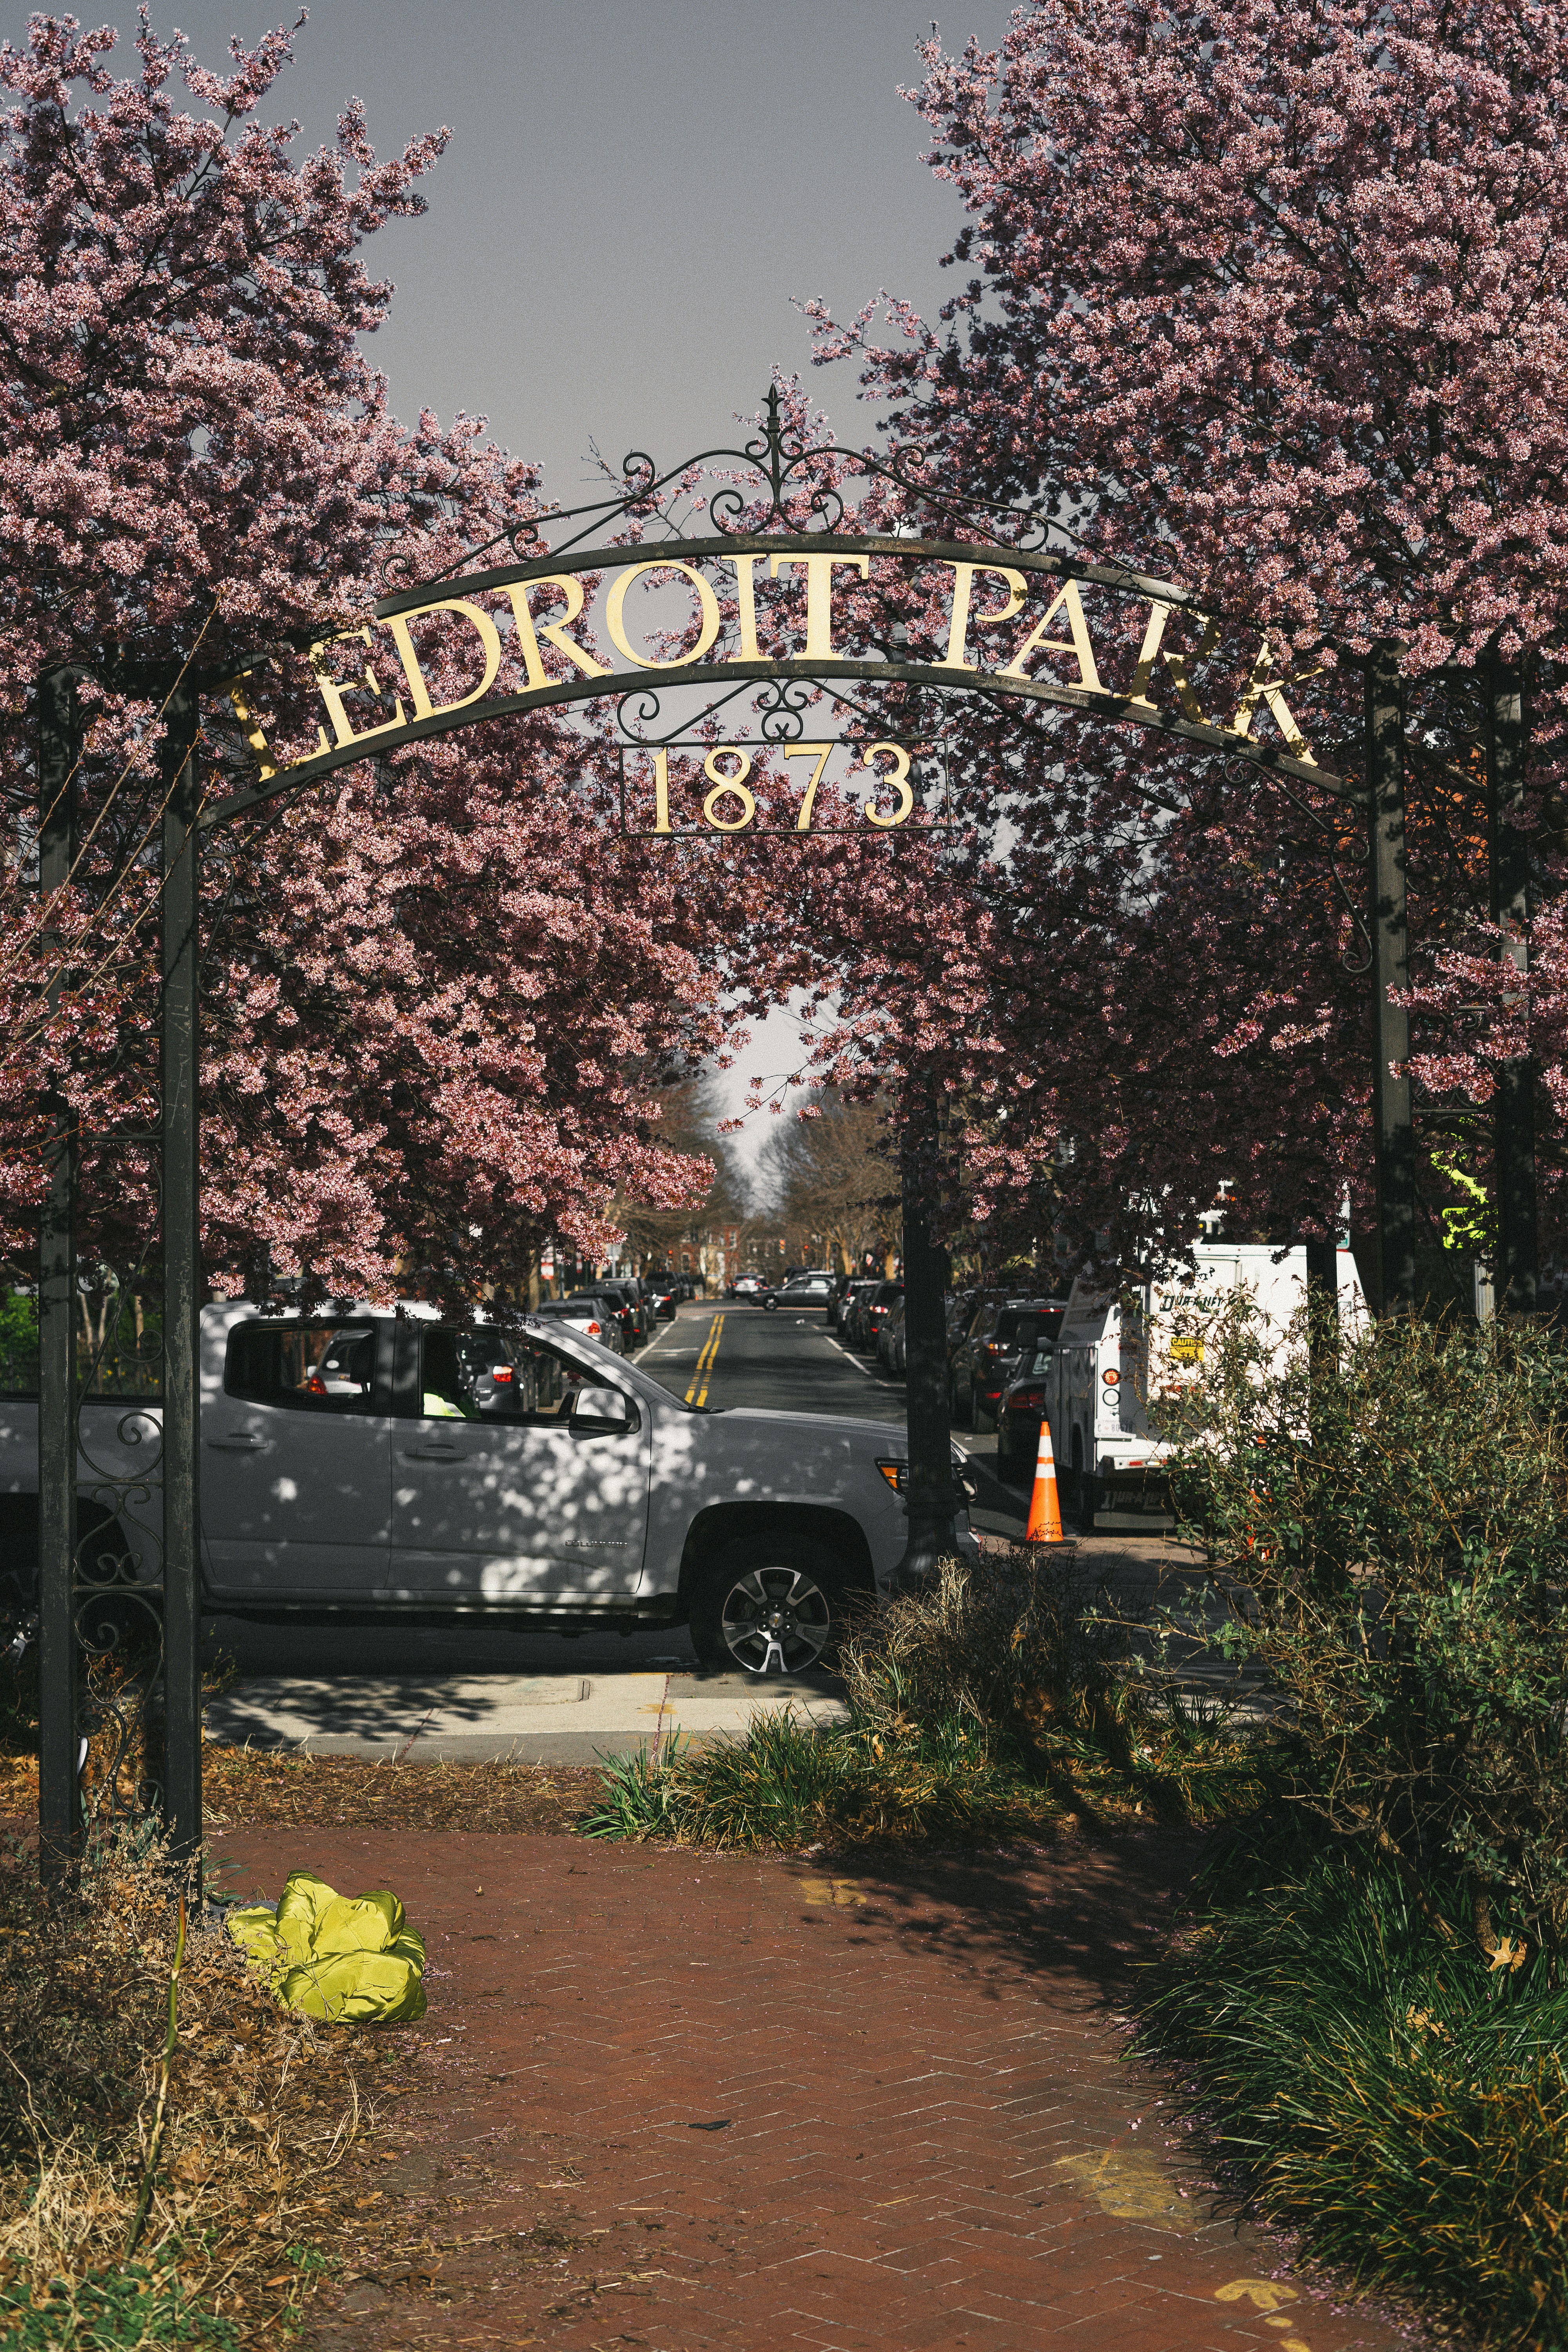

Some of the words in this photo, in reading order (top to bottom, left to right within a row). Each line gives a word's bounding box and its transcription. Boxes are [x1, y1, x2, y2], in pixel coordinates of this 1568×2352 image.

[210, 553, 869, 782] LEDROIT
[931, 561, 1334, 766] PARK
[652, 742, 913, 833] 1873
